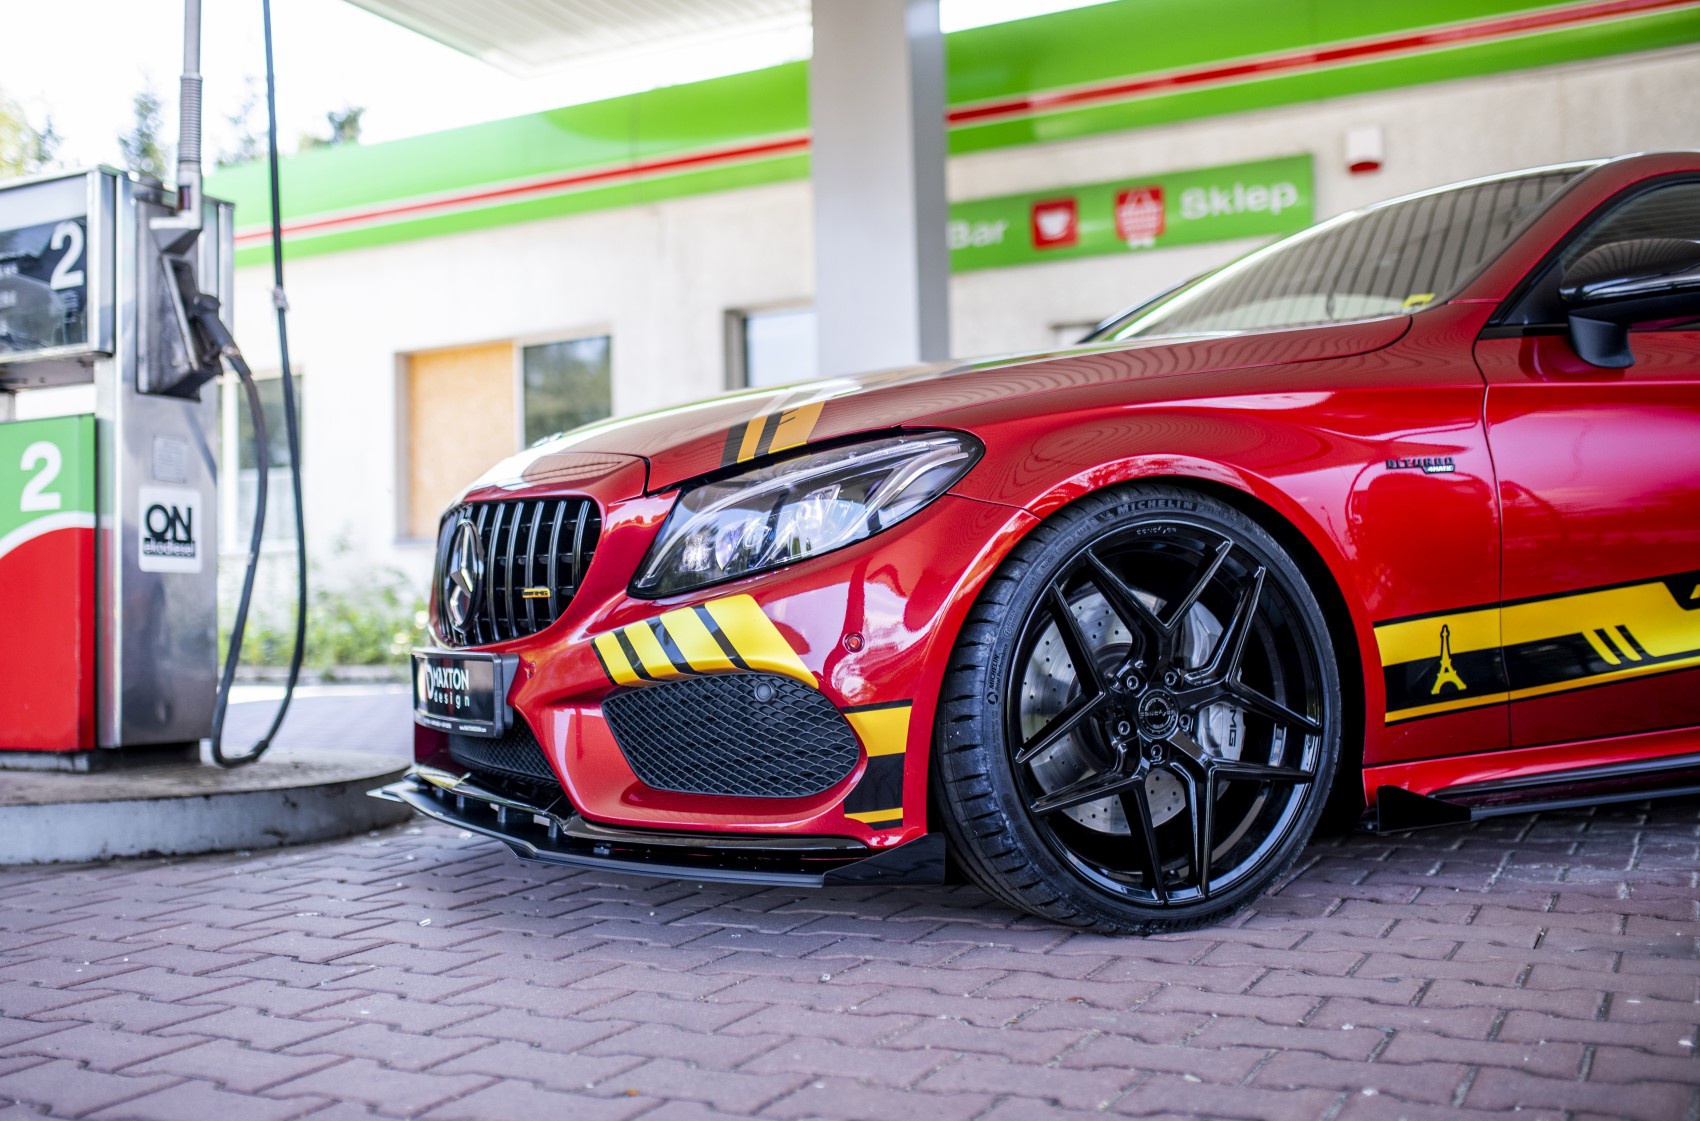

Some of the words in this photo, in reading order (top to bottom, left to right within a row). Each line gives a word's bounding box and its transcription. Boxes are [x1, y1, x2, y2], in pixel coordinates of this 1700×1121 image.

[1180, 182, 1298, 219] Sklep
[947, 219, 1007, 250] Bar
[50, 220, 84, 291] 2
[20, 440, 62, 512] 2
[146, 504, 192, 542] ON
[1116, 500, 1193, 515] MICHELIN
[433, 666, 469, 690] MAXTON
[433, 690, 470, 709] design
[1229, 706, 1237, 747] MG
